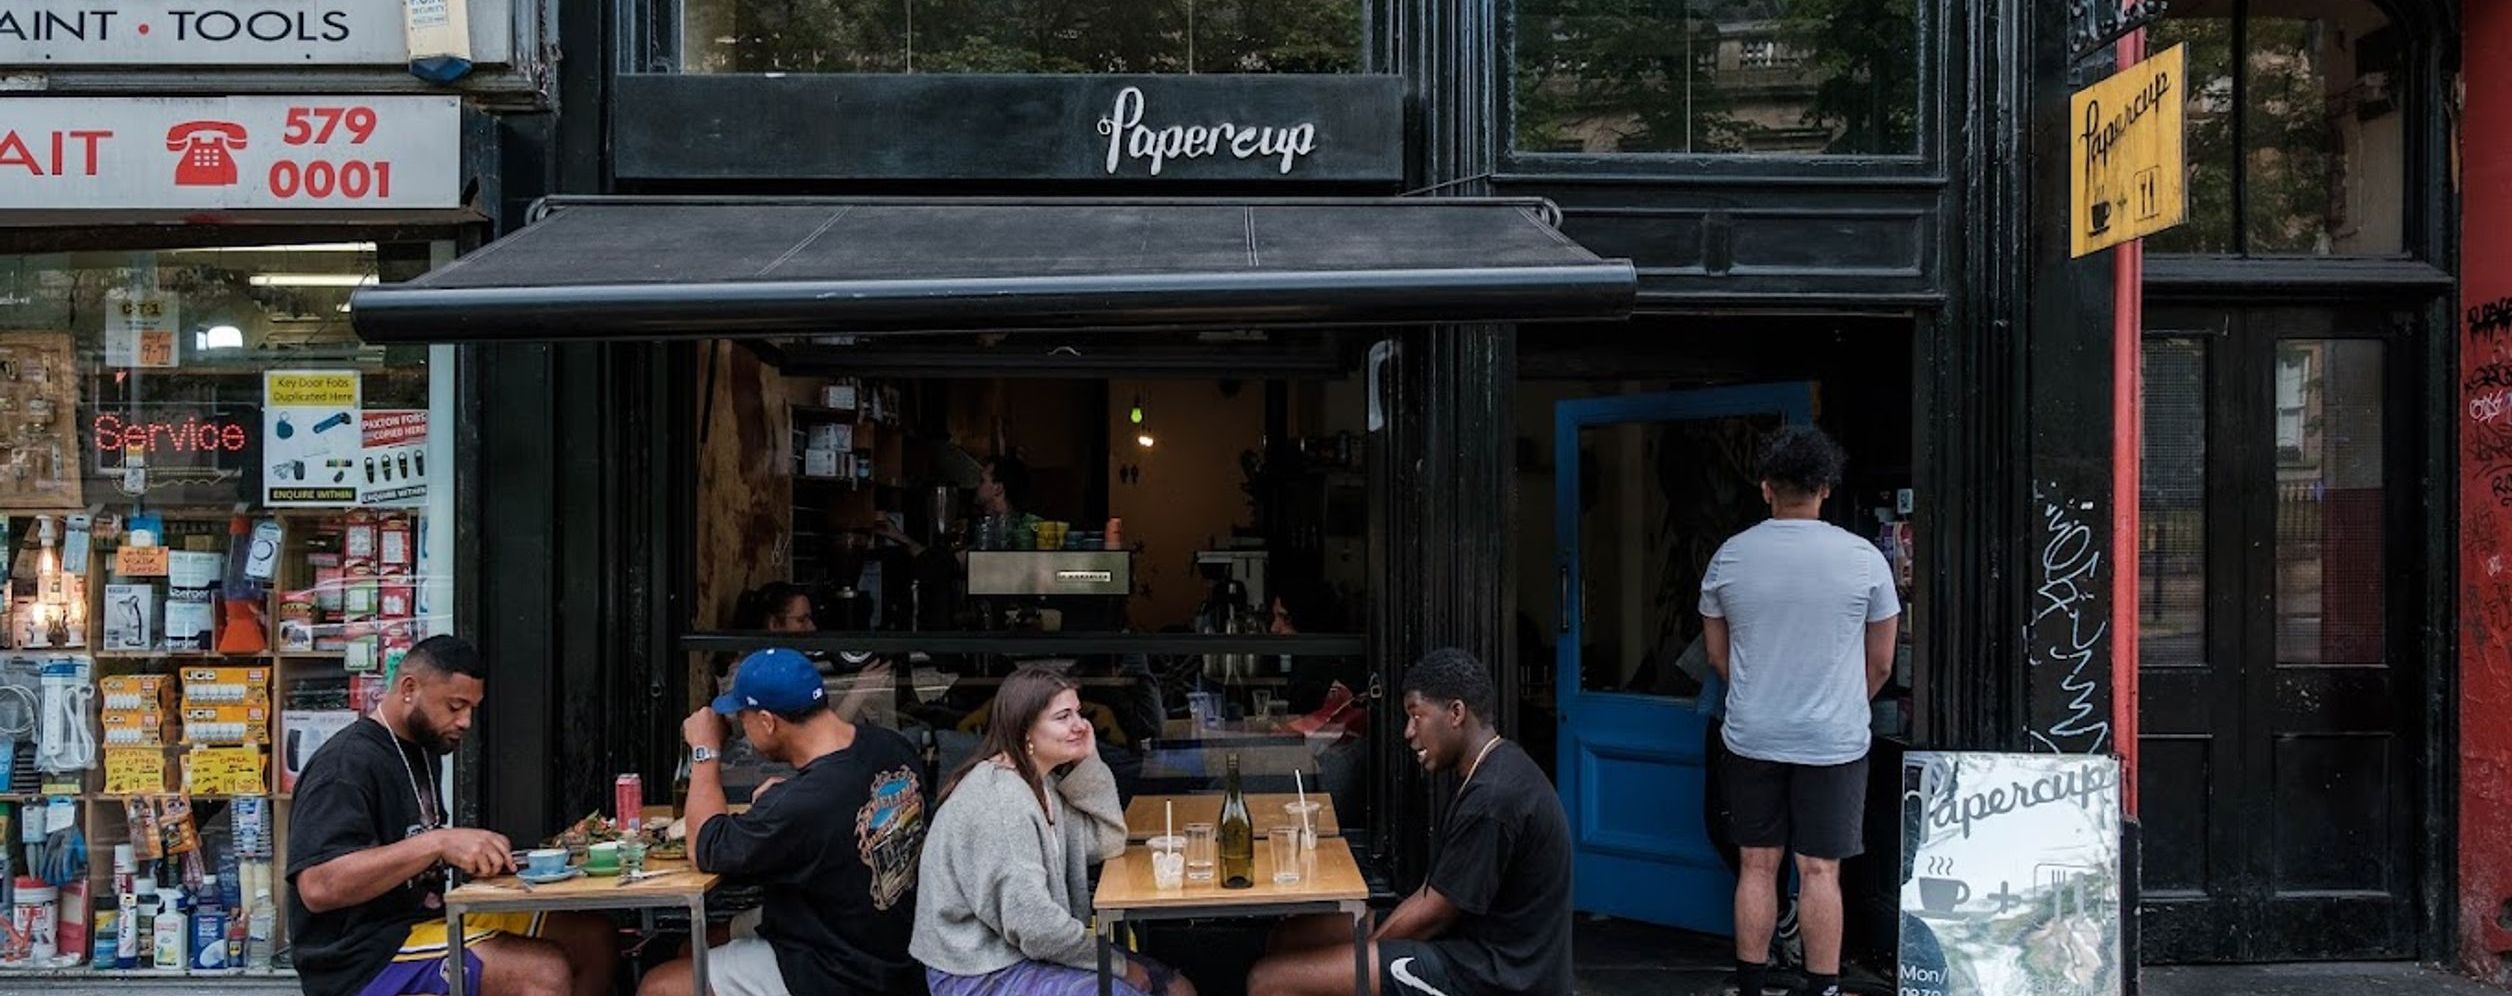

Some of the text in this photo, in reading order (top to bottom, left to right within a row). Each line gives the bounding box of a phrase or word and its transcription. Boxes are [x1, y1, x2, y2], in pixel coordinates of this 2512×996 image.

[168, 10, 350, 41] TOOLS
[283, 107, 377, 145] 579
[1097, 86, 1317, 175] Papercup
[2078, 71, 2171, 167] Papercup
[0, 130, 113, 176] AIT
[268, 160, 390, 198] 0001
[273, 391, 352, 403] Duplicated Here
[278, 377, 349, 389] Key Door Fobs
[94, 414, 245, 451] Service
[362, 418, 400, 431] PAXTON
[373, 424, 427, 441] COPIED HERE
[273, 488, 352, 500] ENQUIRE WITHIN
[185, 670, 216, 680] JCB
[186, 709, 216, 719] JCB
[1903, 757, 2118, 844] Papercup
